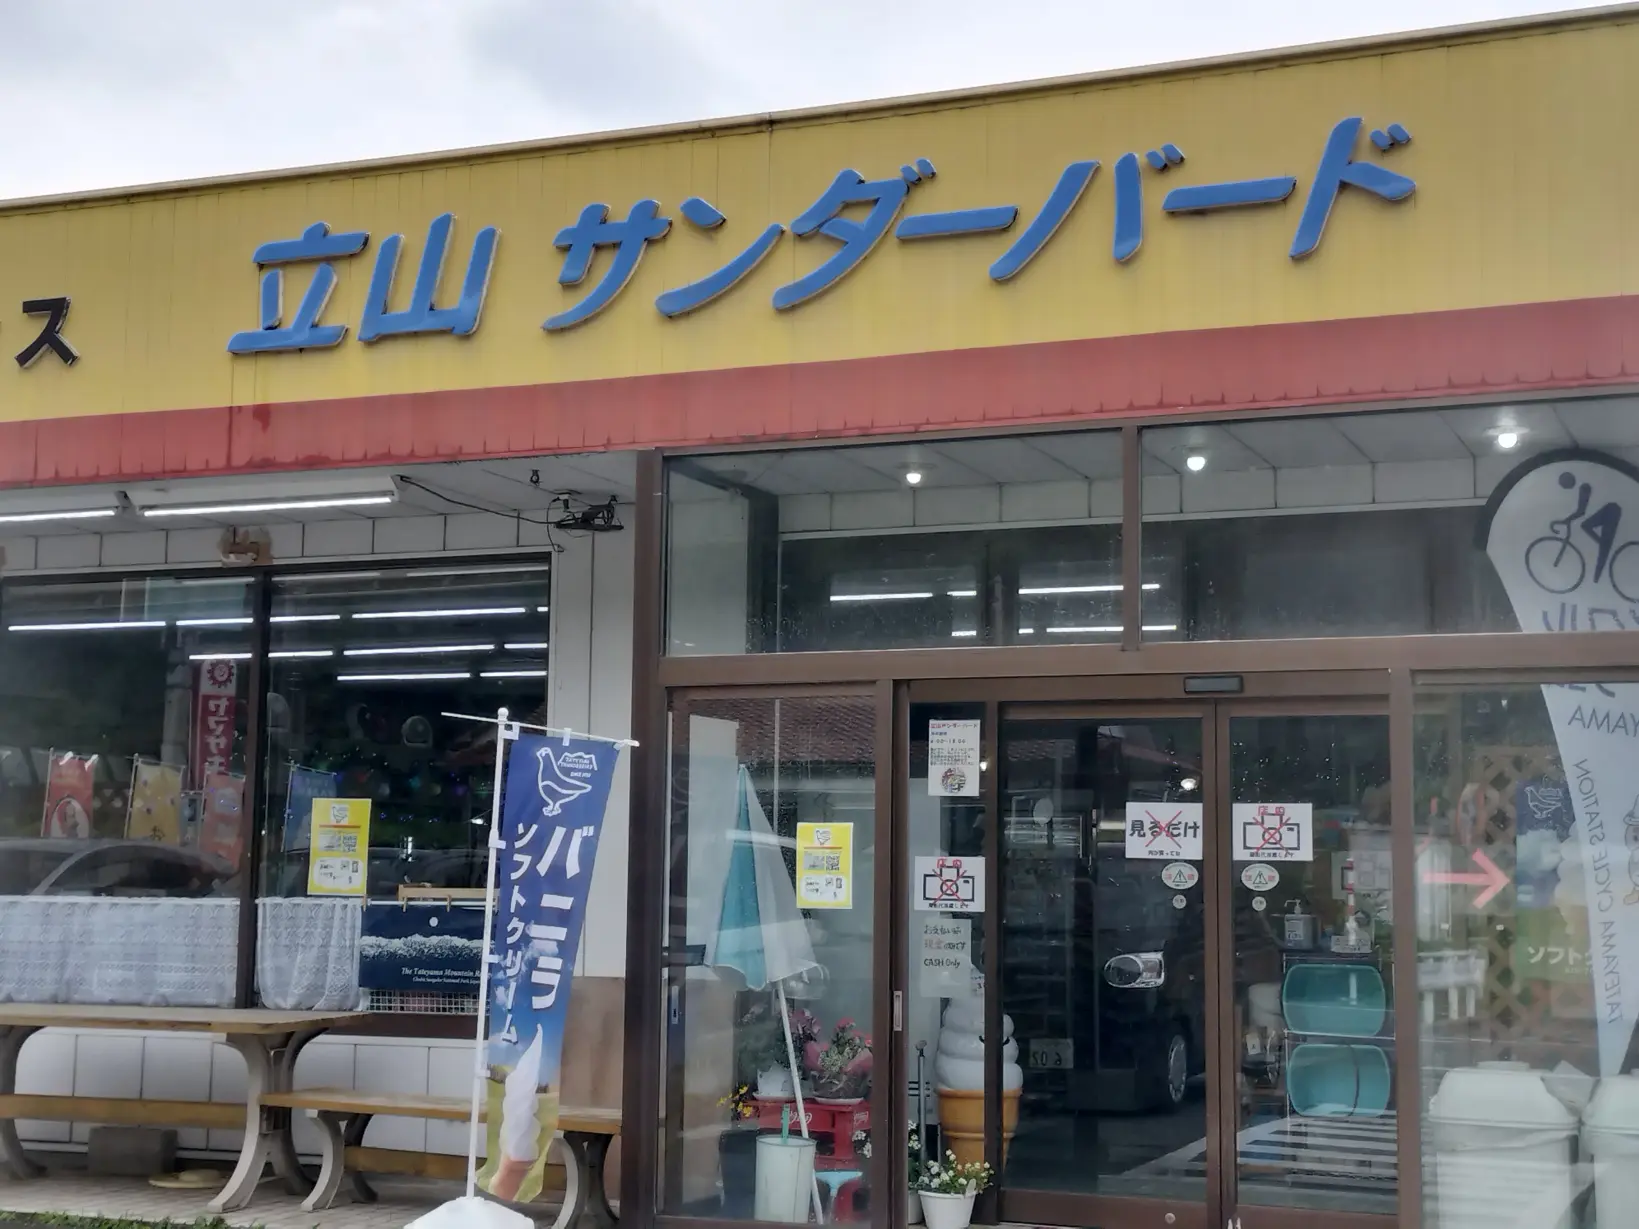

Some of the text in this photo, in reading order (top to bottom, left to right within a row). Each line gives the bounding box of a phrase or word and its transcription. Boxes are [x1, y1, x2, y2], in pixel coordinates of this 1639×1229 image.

[14, 296, 80, 369] ス
[227, 116, 1417, 355] 立山 サンダーバード
[502, 822, 538, 1044] ソフトクリーム
[535, 825, 595, 1010] バニラ
